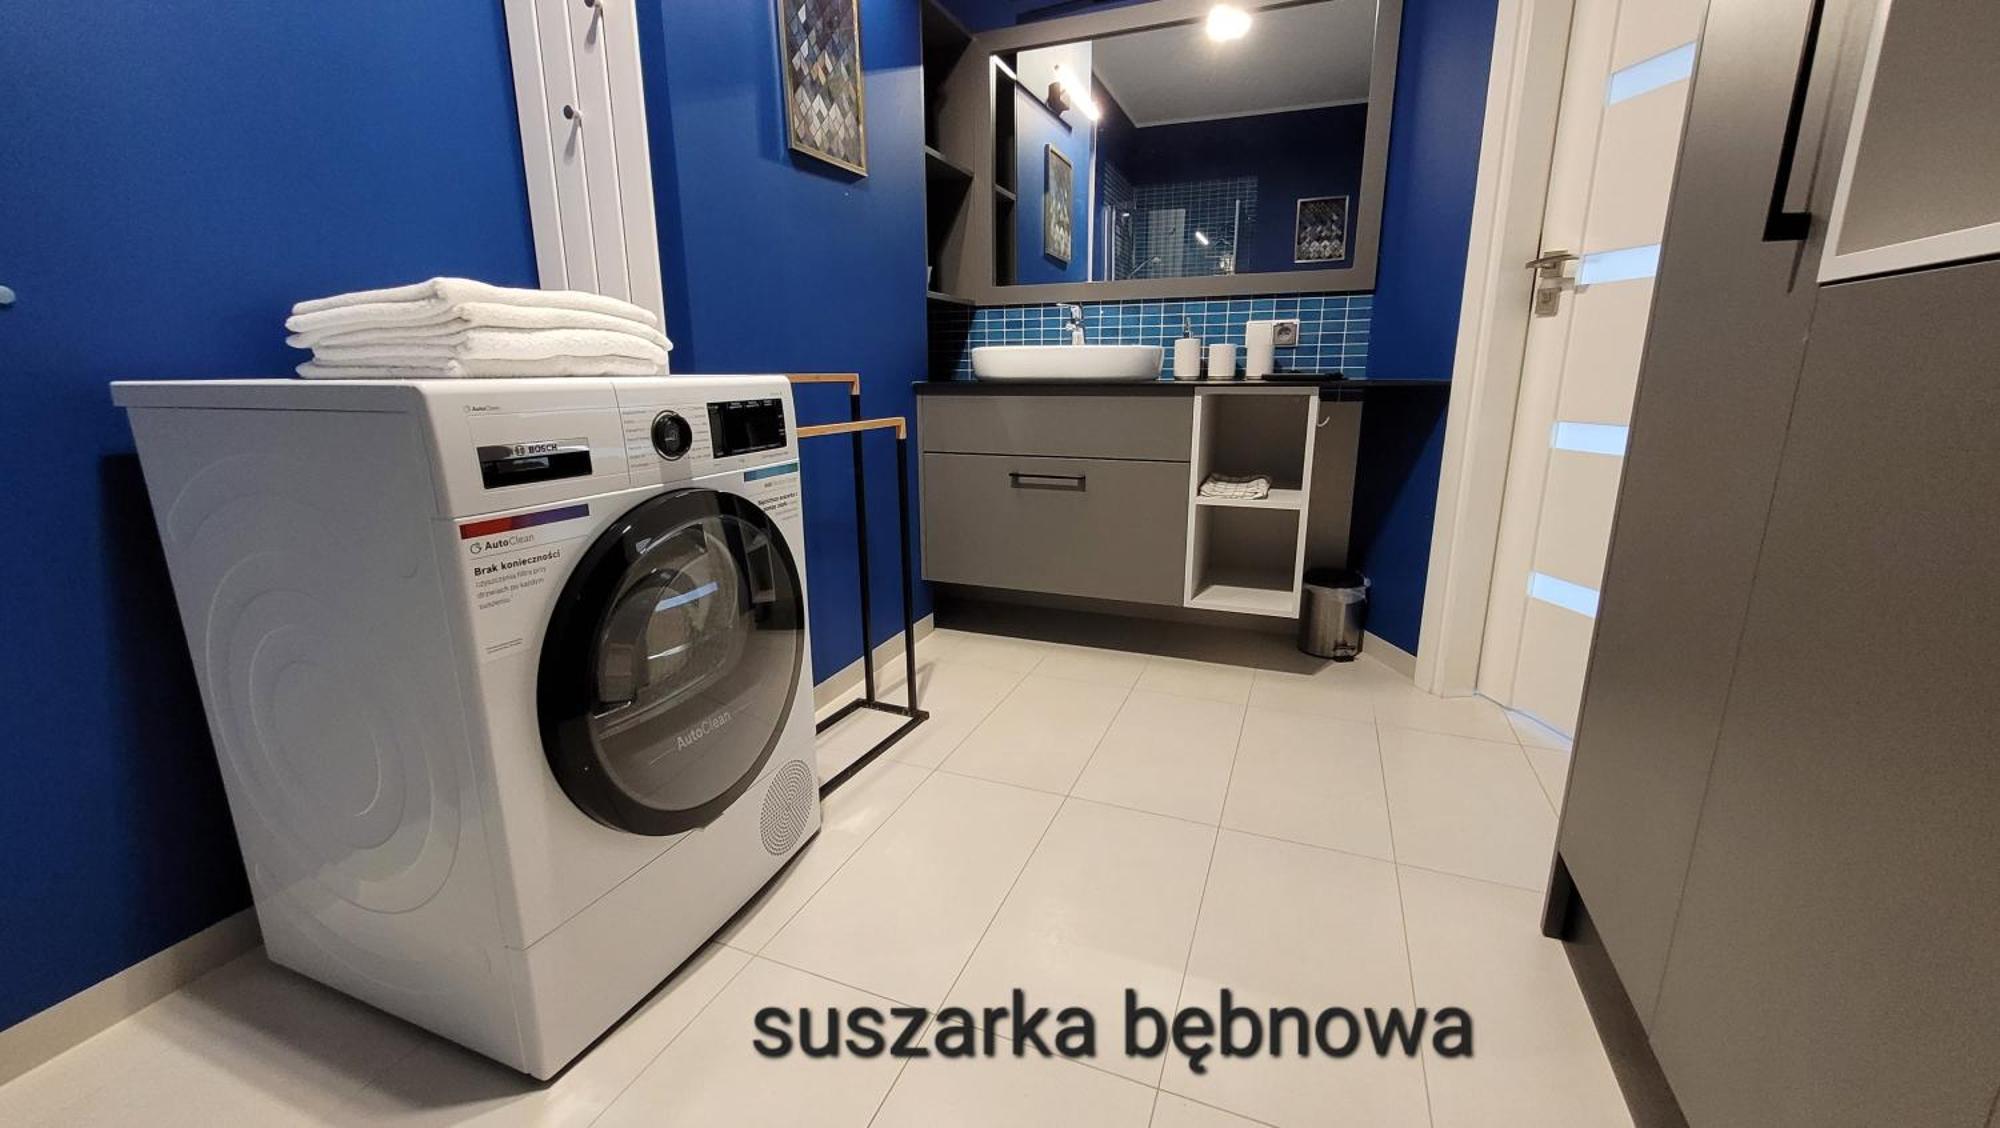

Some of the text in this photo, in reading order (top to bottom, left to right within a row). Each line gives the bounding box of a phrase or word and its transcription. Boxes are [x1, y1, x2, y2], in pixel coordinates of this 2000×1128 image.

[528, 443, 558, 454] BOSCH
[485, 534, 535, 551] AutoClean
[474, 549, 561, 576] Brak konieczności
[676, 711, 732, 752] AutoClean
